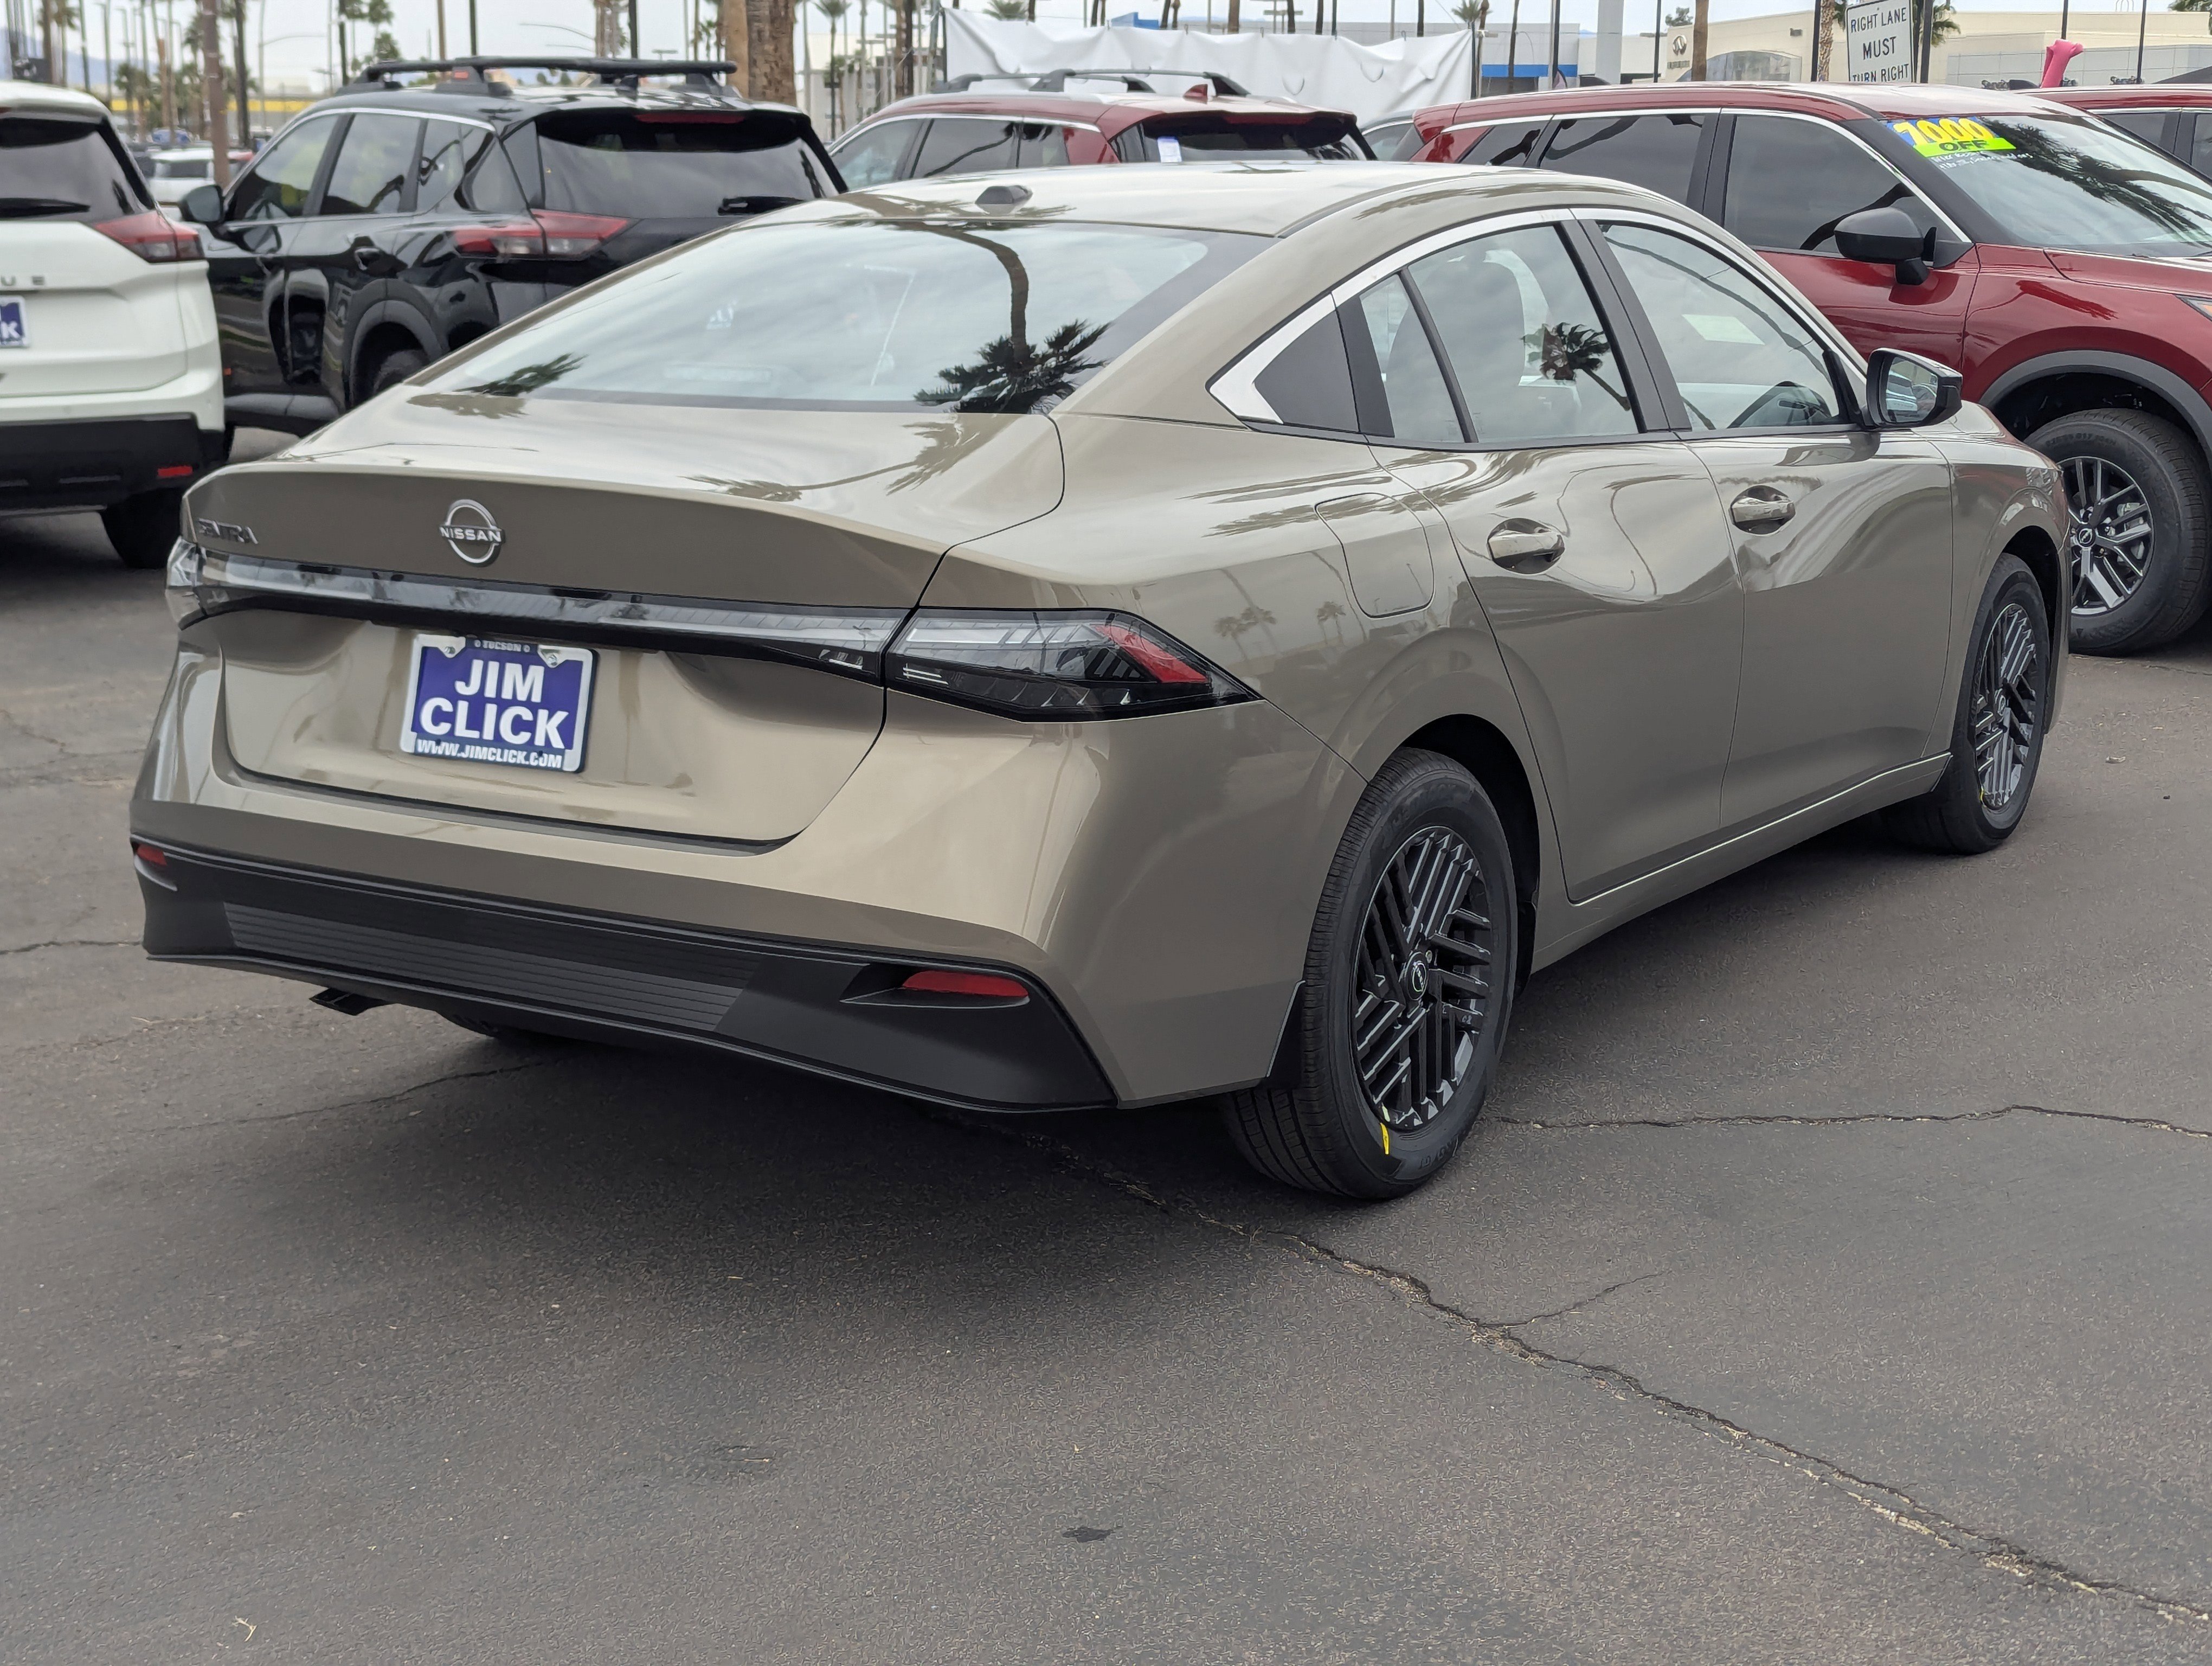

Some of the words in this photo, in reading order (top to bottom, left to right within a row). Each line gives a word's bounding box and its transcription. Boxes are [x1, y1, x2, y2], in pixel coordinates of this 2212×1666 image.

[1851, 14, 1878, 33] RIGHT
[1881, 7, 1907, 26] LANE
[1863, 36, 1896, 60] MUST
[1881, 63, 1909, 82] RIGHT
[1939, 139, 1988, 151] OFF
[439, 527, 501, 542] NISSAN
[482, 639, 522, 652] TUCSON
[454, 659, 544, 703] JIM
[420, 697, 569, 749] CLICK
[417, 739, 562, 768] WWW.JIMCLICK.COM
